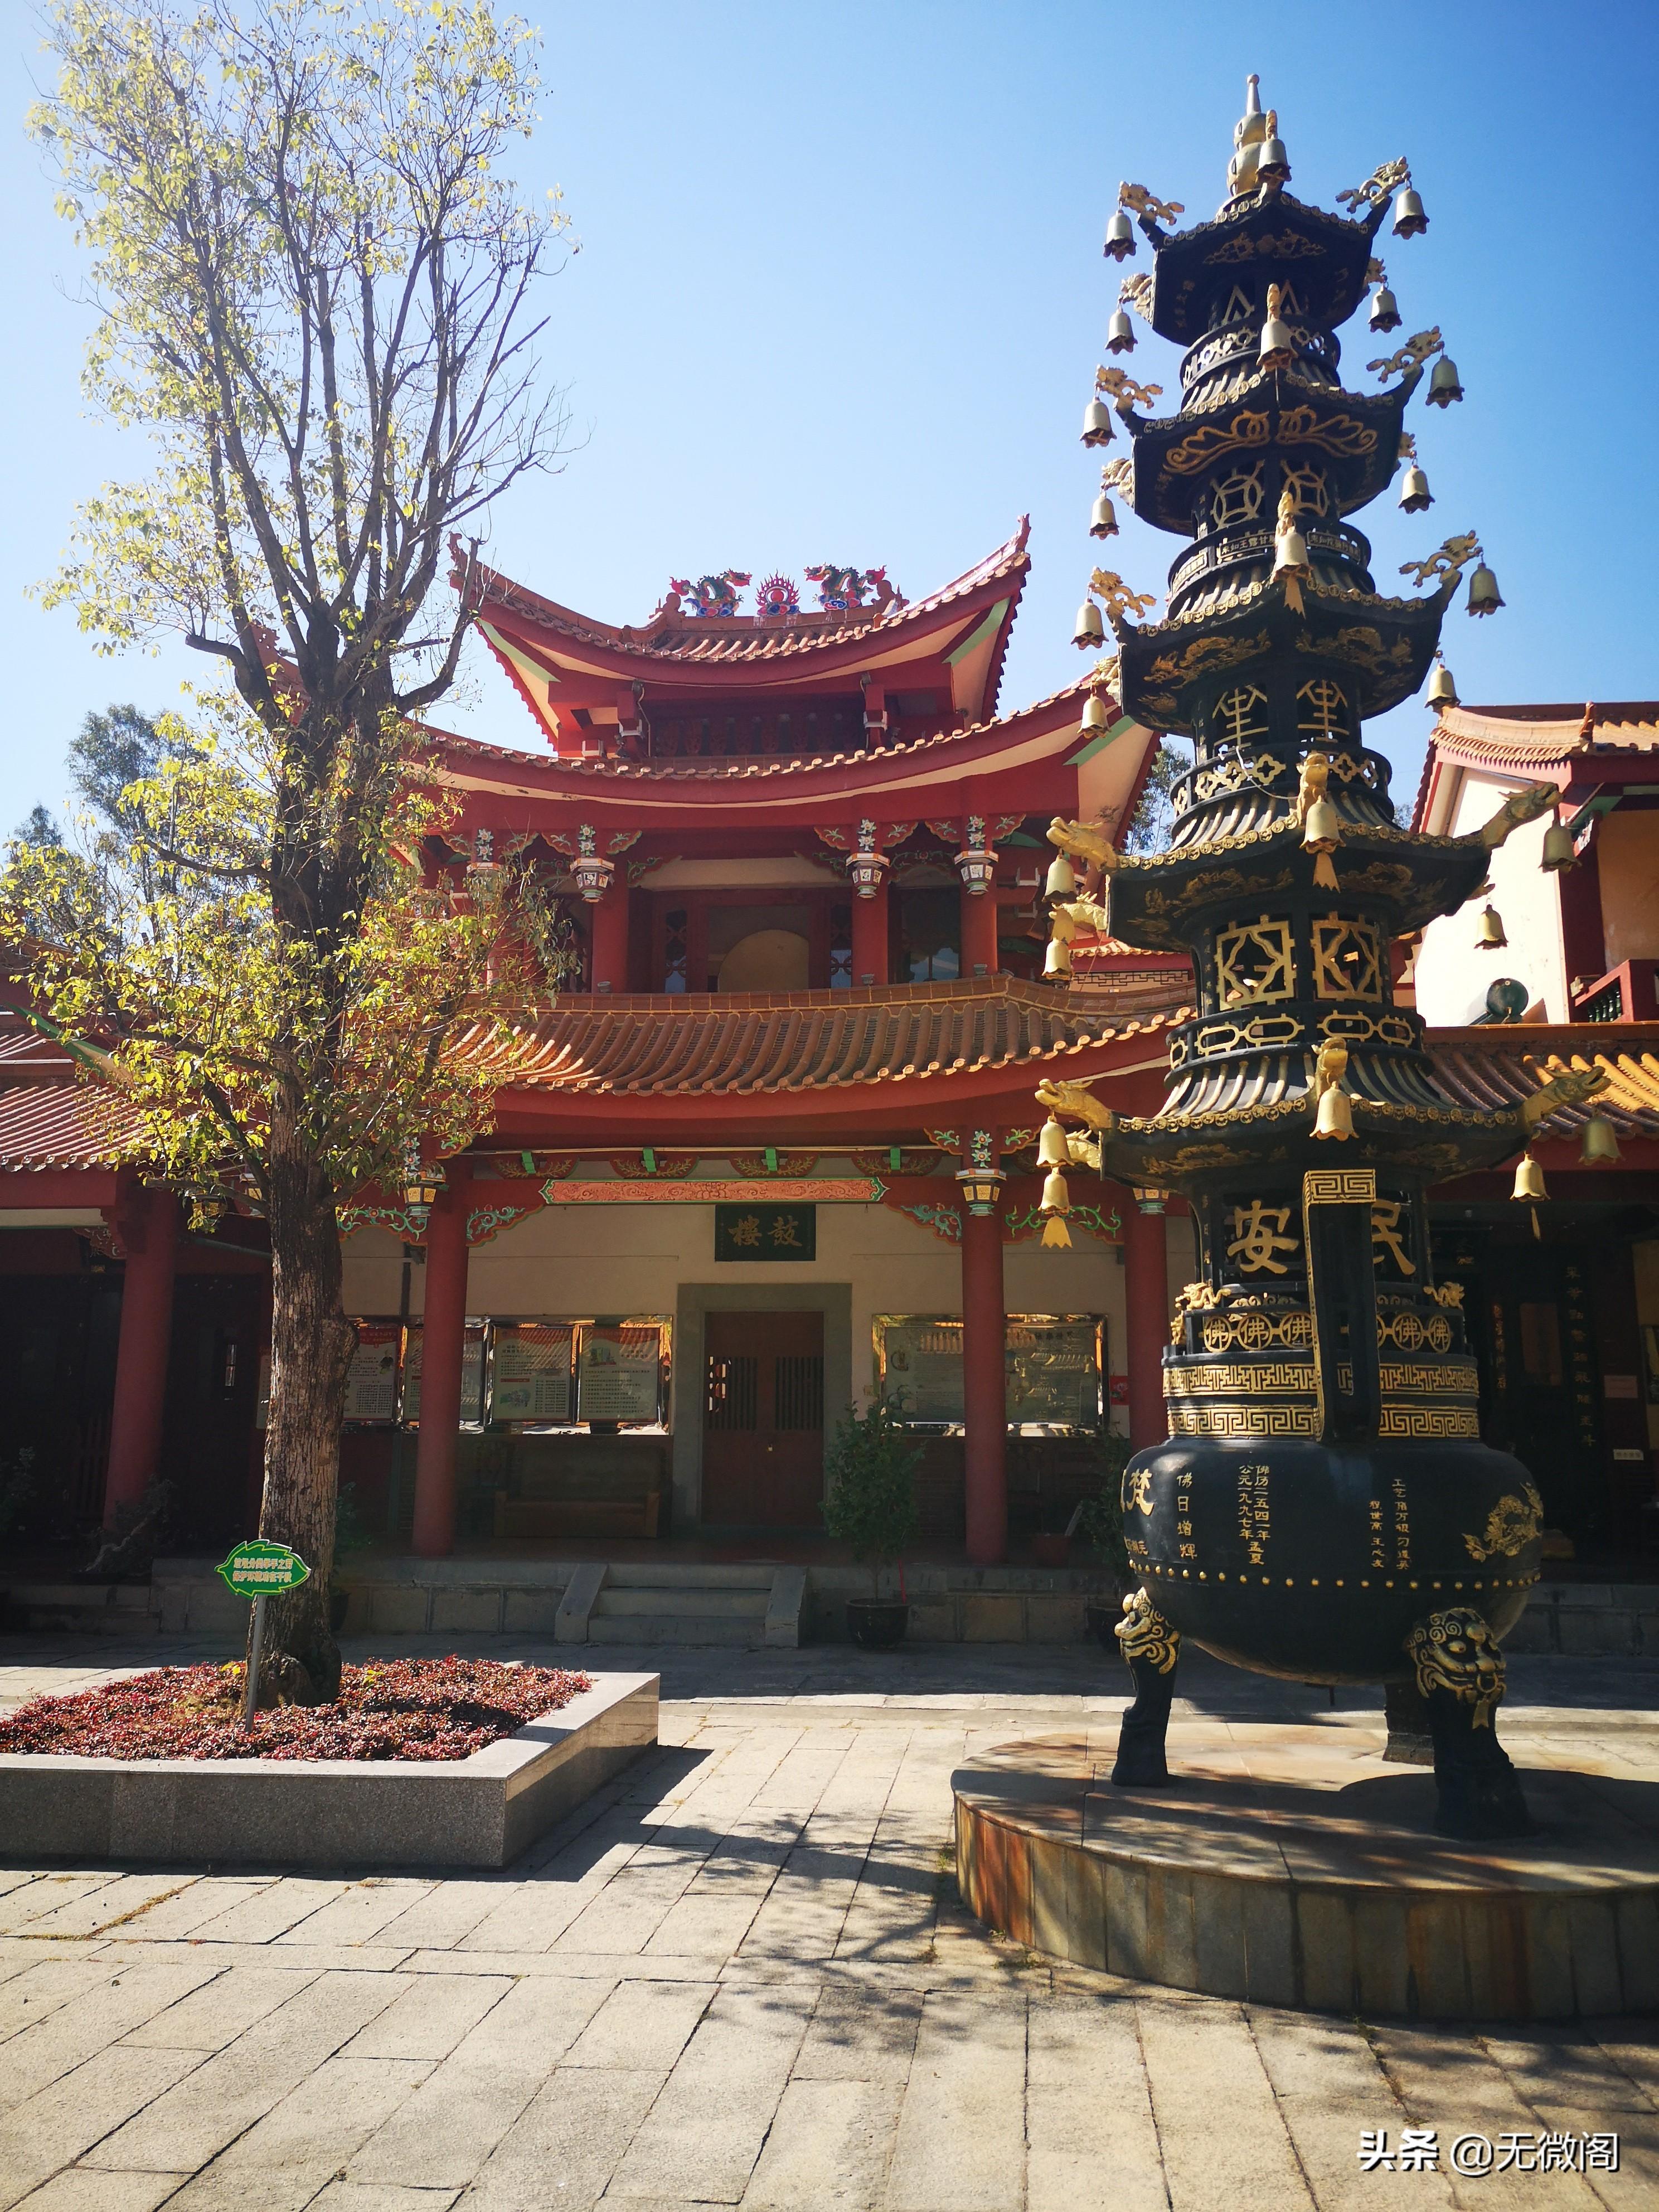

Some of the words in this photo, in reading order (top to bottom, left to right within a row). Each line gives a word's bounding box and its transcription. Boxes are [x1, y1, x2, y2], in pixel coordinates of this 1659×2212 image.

[1227, 1200, 1299, 1274] 安
[1371, 1199, 1416, 1274] 民
[1207, 1317, 1228, 1349] 佛
[1241, 1316, 1268, 1349] 佛
[1283, 1315, 1311, 1347] 佛
[1395, 1317, 1422, 1350] 佛
[1431, 1318, 1448, 1351] 佛
[1126, 1468, 1154, 1516] 梵
[1238, 1464, 1253, 1540] 公元一九九七年
[232, 1571, 292, 1583] 保护环境功在千秋
[234, 1558, 293, 1569] 垃圾分类举手之劳
